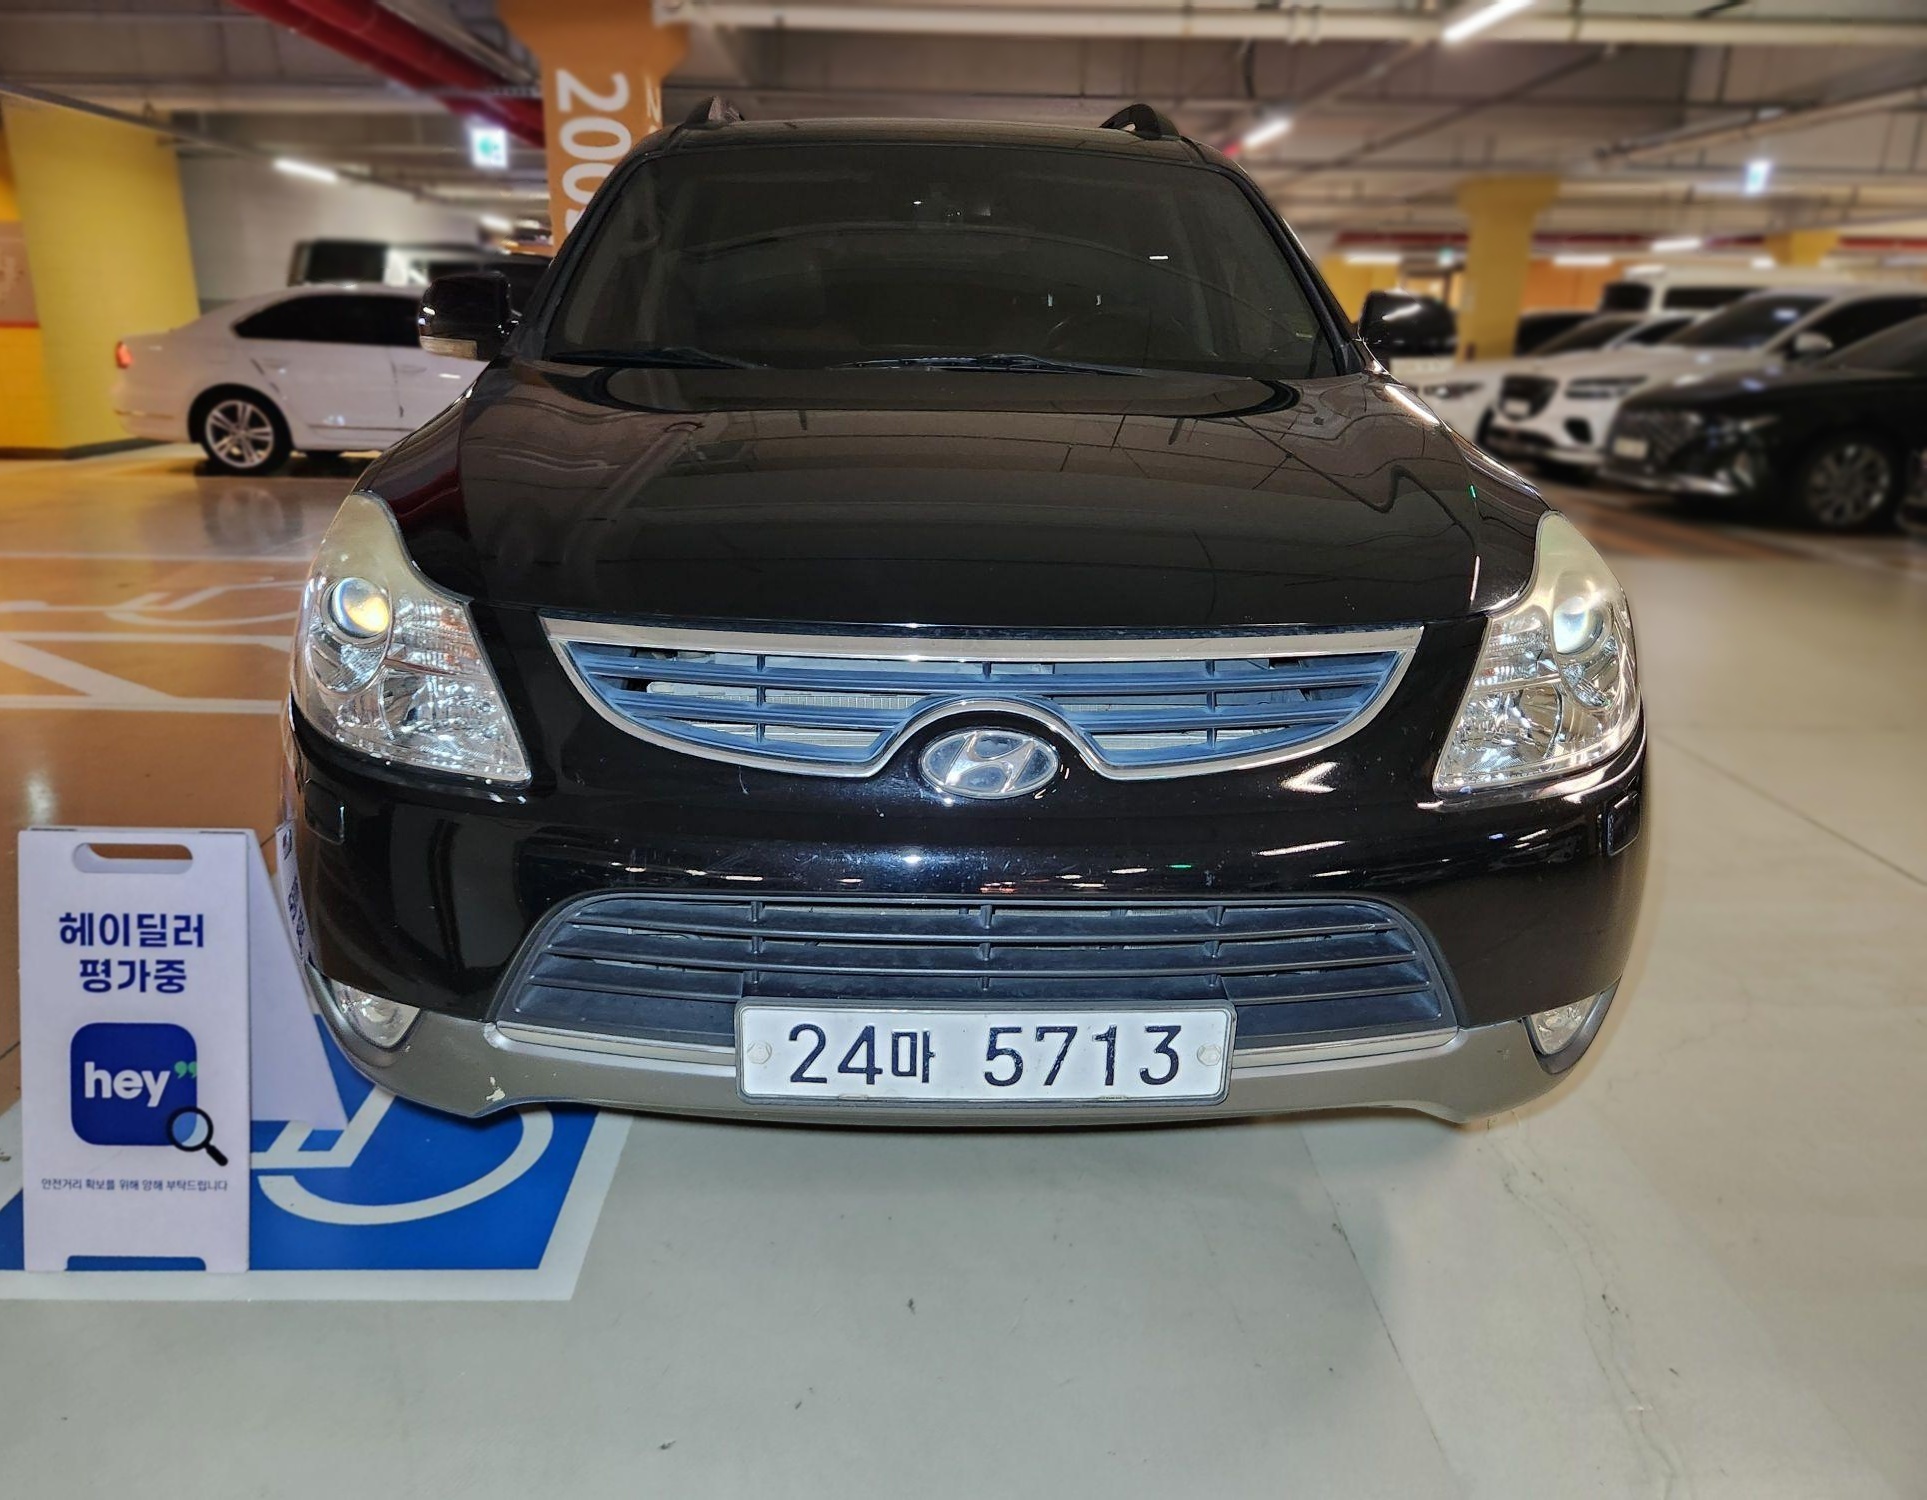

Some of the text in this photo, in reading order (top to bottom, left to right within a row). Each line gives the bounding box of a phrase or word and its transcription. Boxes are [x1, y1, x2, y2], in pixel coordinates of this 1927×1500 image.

[555, 68, 633, 234] 200
[59, 912, 204, 948] 헤이딜러
[79, 958, 187, 994] 평가중
[788, 1023, 1182, 1087] 24마 5713
[84, 1061, 171, 1107] hey
[41, 1178, 228, 1192] 안전거리 확보를 위해 양해 부탁드립니다
